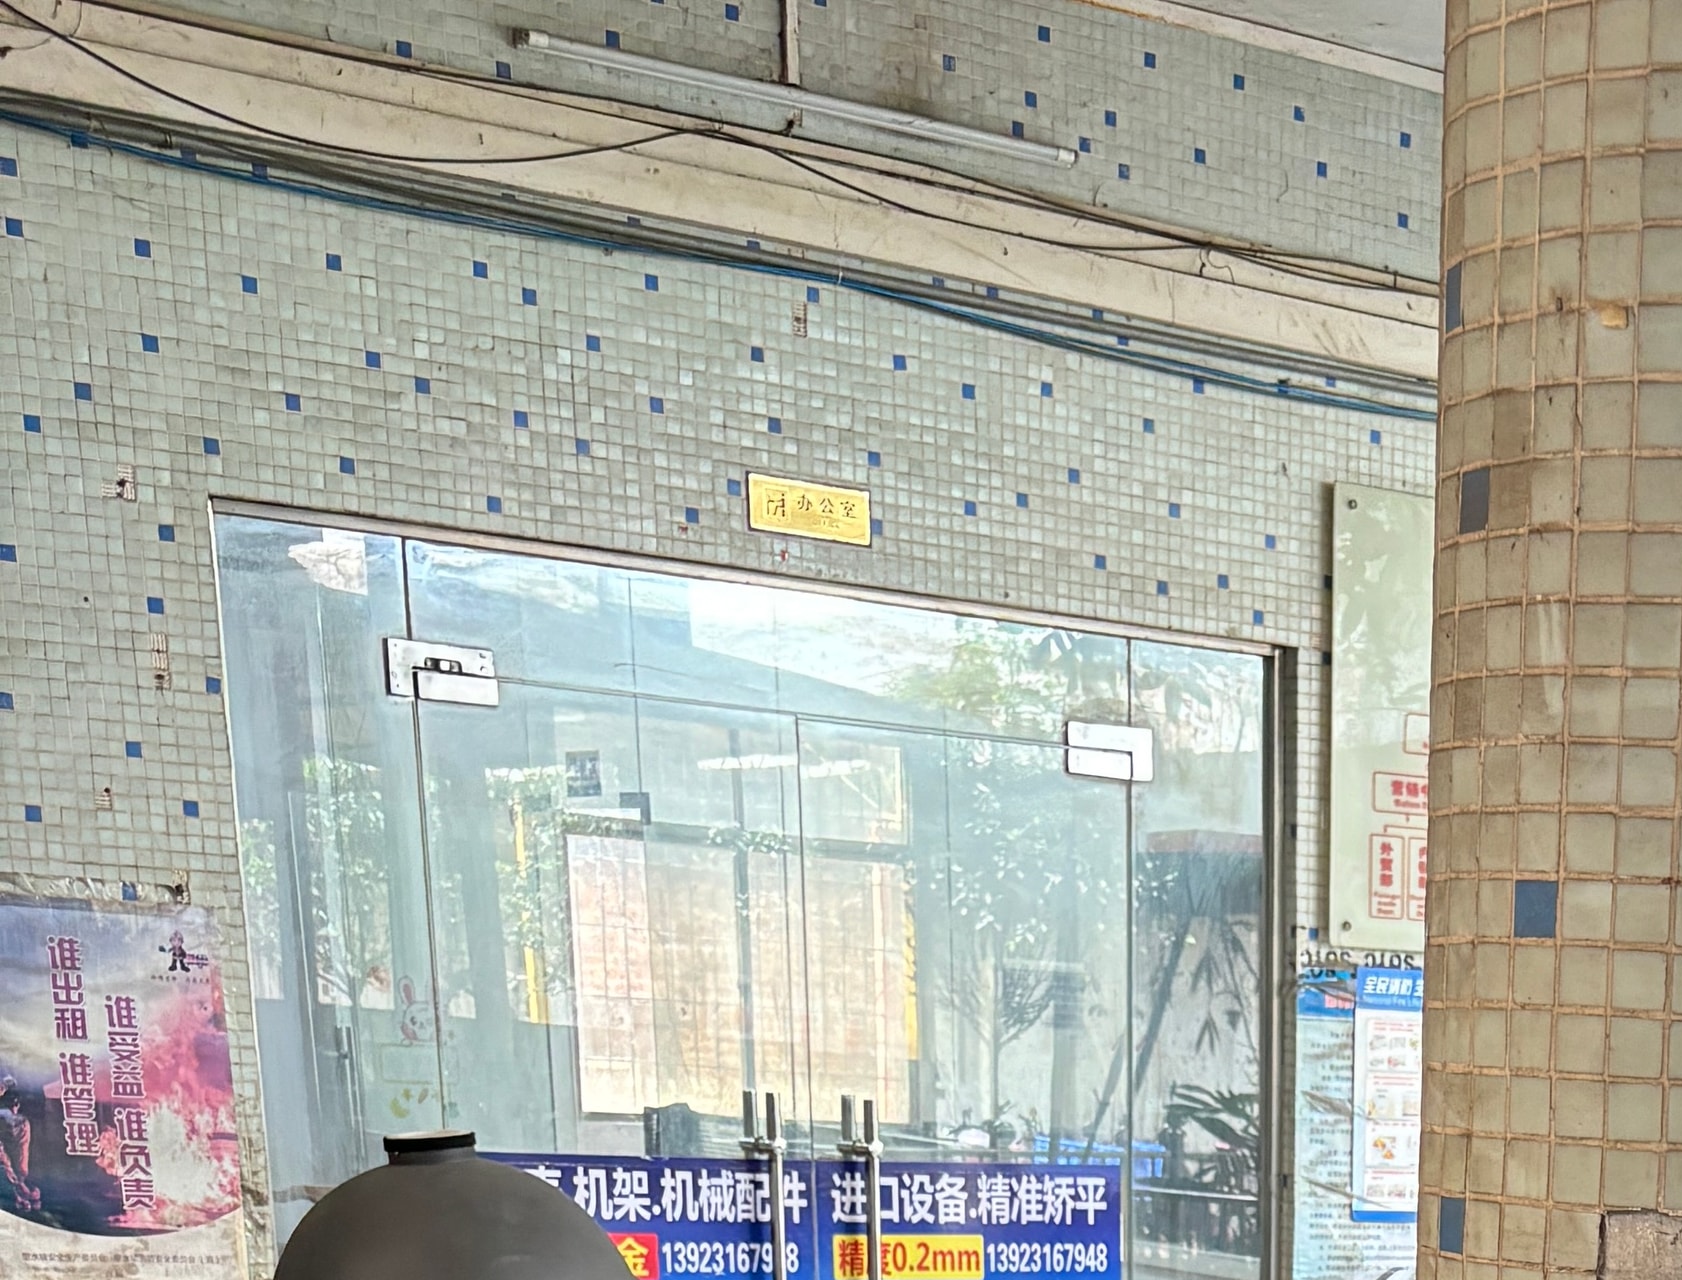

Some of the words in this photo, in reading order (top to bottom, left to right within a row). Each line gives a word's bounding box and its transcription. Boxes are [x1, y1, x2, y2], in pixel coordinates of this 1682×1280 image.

[797, 493, 858, 519] 办公室
[47, 935, 89, 1042] 谁出租
[105, 994, 147, 1099] 谁受益
[59, 1051, 101, 1157] 谁管理
[114, 1108, 156, 1212] 谁负责
[662, 1241, 800, 1274] 1392316798
[986, 1242, 1109, 1274] 13923167948
